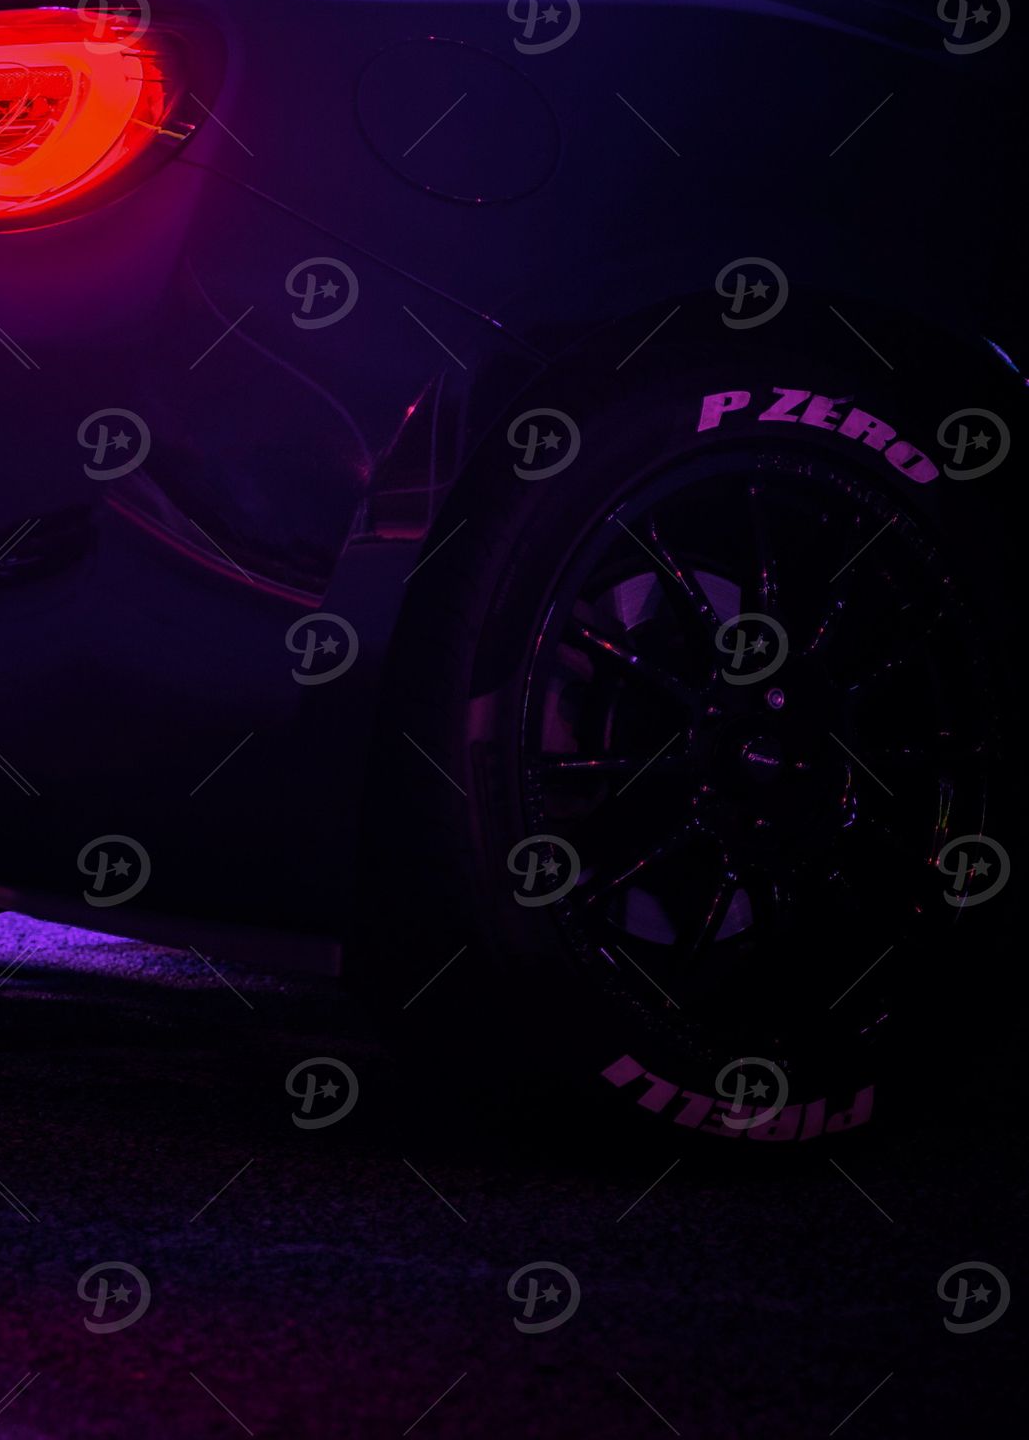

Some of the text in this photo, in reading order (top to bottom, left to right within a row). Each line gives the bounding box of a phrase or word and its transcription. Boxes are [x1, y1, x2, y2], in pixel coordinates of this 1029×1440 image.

[697, 386, 940, 483] P ZERO
[600, 1054, 876, 1142] PIRELLI
